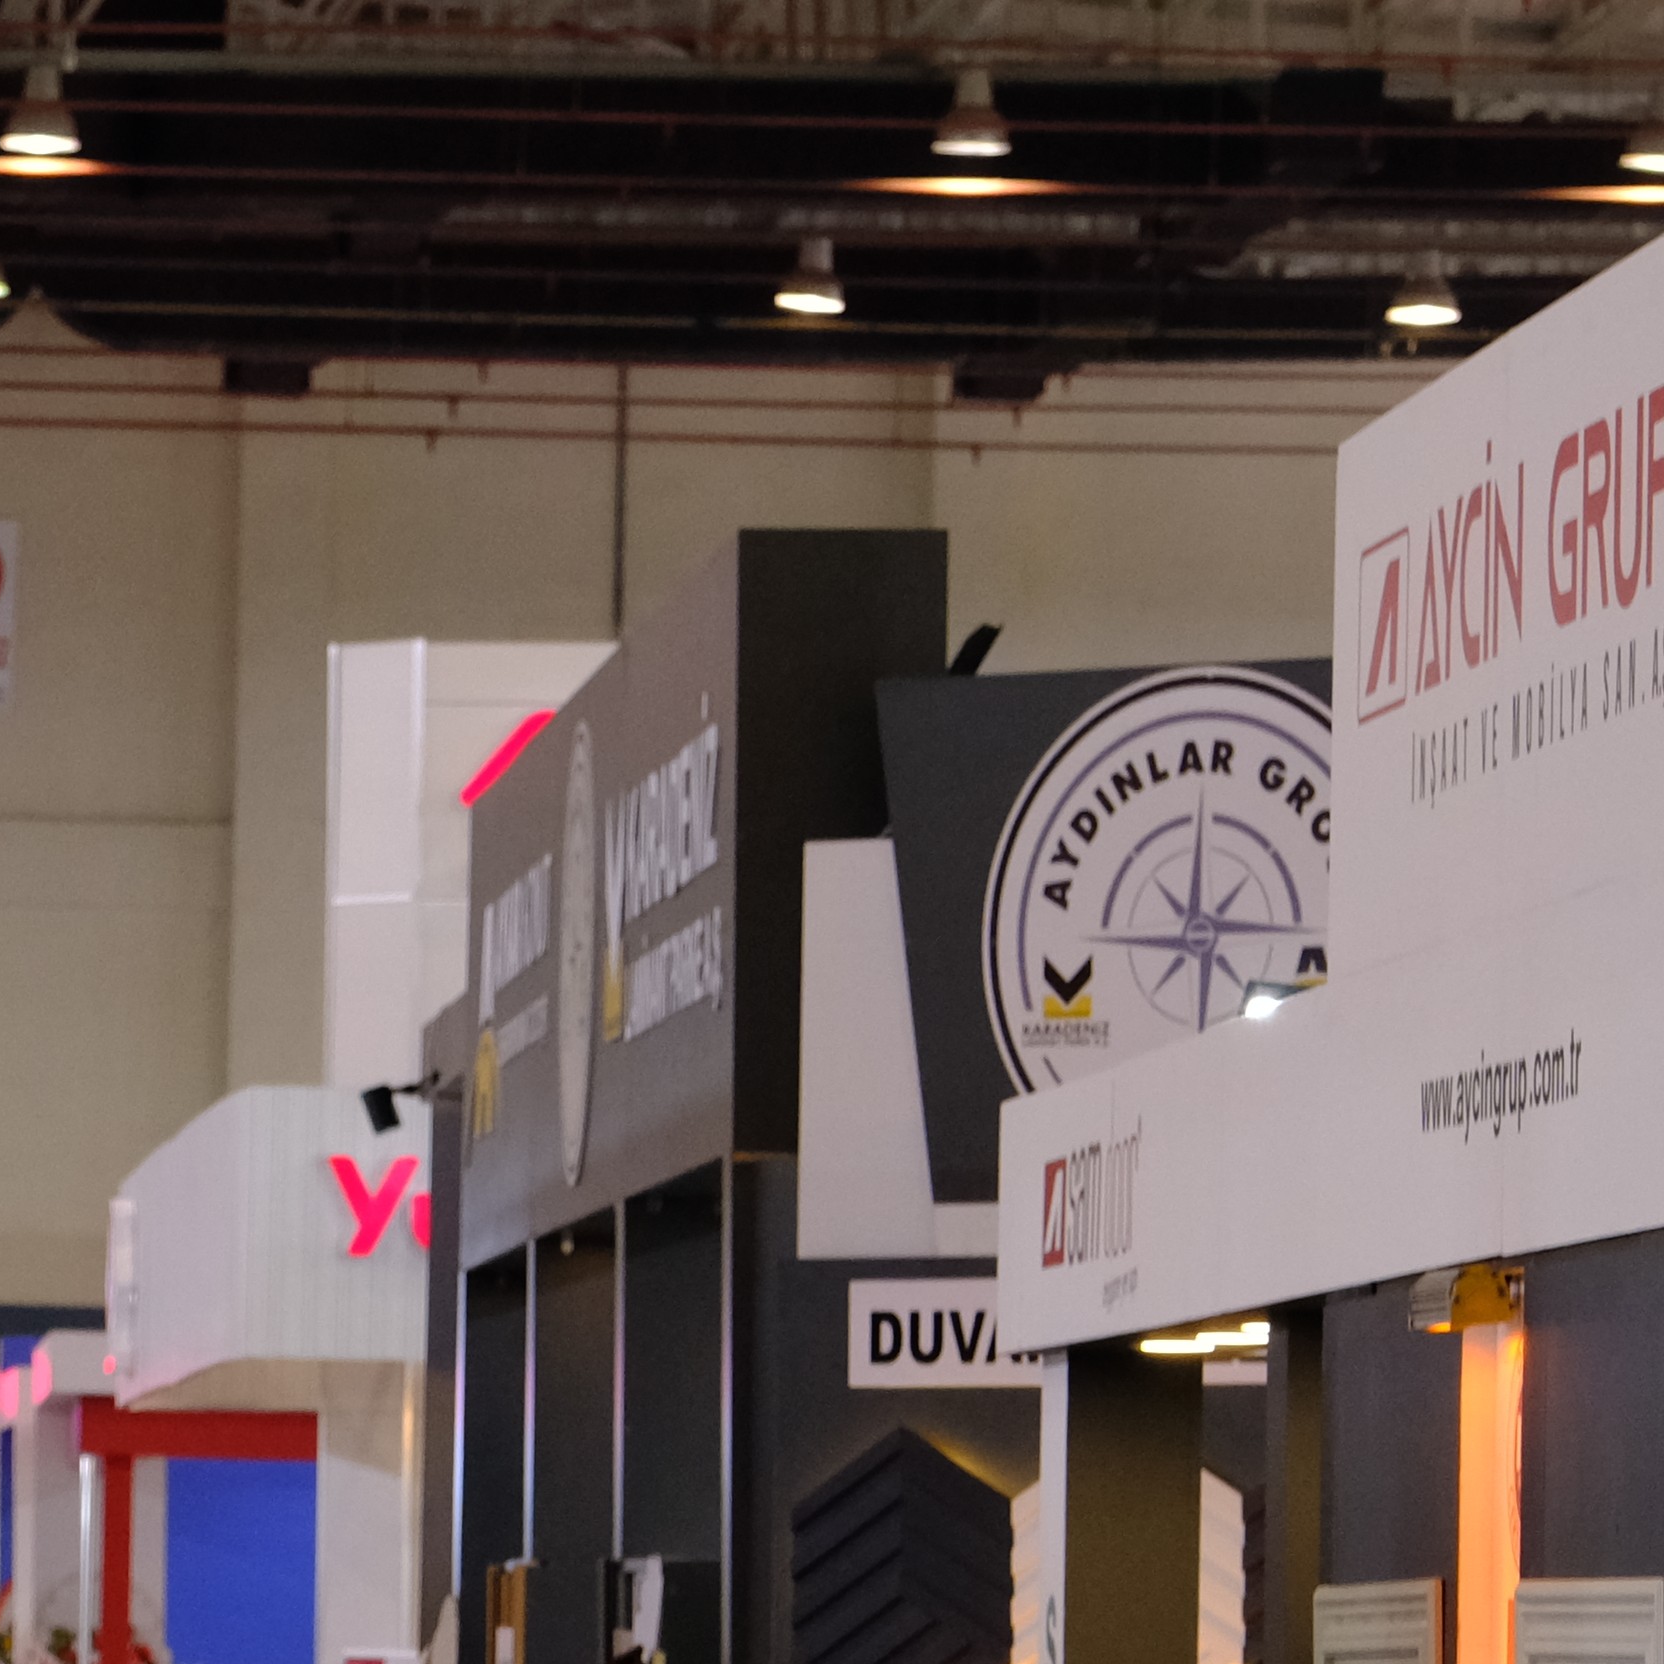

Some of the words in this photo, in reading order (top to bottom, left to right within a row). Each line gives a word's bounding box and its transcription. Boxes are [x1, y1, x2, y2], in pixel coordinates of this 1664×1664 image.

[1480, 702, 1499, 775] VE
[1511, 661, 1589, 762] MOBİLYA
[1042, 738, 1235, 911] AYDINLAR
[1420, 1027, 1582, 1145] www.aycingrup.com.tr
